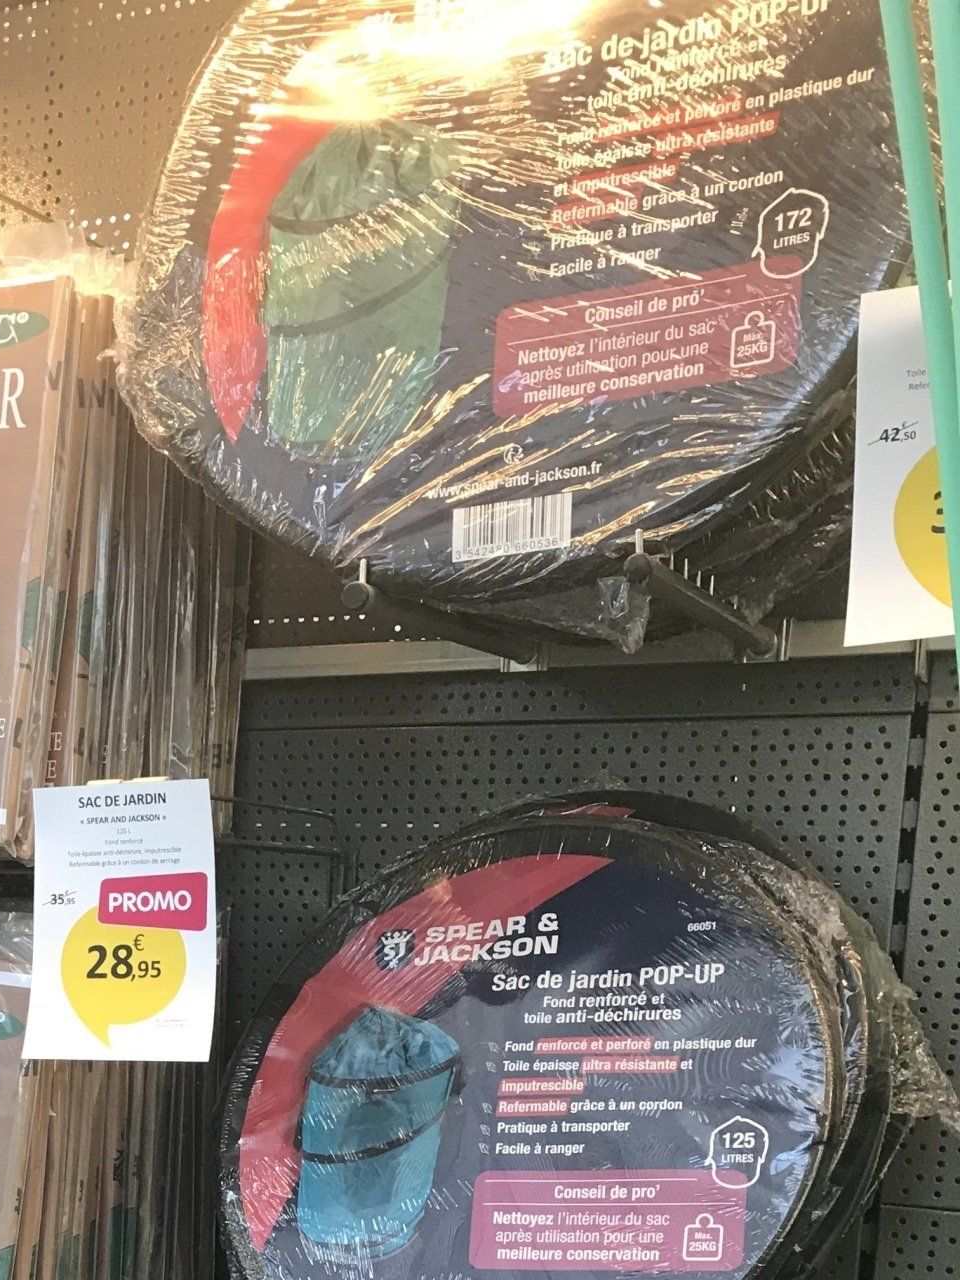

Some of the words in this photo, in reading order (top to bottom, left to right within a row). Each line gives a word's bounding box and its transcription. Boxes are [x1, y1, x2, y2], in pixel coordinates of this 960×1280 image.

[601, 34, 634, 61] de
[641, 17, 722, 58] jardin
[745, 94, 765, 109] en
[769, 76, 843, 106] plastique
[846, 66, 875, 86] dur
[552, 197, 638, 225] Refermable
[705, 182, 725, 197] un
[729, 169, 784, 194] cordon
[617, 222, 627, 239] à
[631, 207, 720, 238] transporter
[774, 208, 812, 232] 172
[773, 231, 811, 250] LITRES
[549, 258, 593, 279] Facile
[596, 252, 606, 269] à
[585, 298, 642, 324] Conseil
[647, 296, 667, 314] de
[518, 341, 585, 366] Nettoyez
[589, 328, 659, 355] l'intérieur
[664, 323, 684, 341] du
[688, 318, 716, 337] sac
[736, 341, 769, 359] 25KG
[521, 365, 562, 387] après
[566, 352, 637, 378] utilisation
[641, 348, 677, 370] pour
[680, 342, 709, 360] une
[906, 368, 927, 379] Toile
[523, 378, 597, 405] meilleure
[600, 361, 705, 393] conservation
[78, 796, 101, 809] SAC
[104, 795, 120, 807] DE
[123, 792, 167, 807] JARDIN
[86, 815, 109, 825] SPEAR
[110, 814, 127, 823] AND
[128, 813, 160, 823] JACKSON
[108, 889, 192, 913] PROMO
[425, 915, 527, 944] SPEAR
[538, 912, 560, 932] &
[687, 920, 717, 932] 66051
[86, 944, 161, 982] 28,95
[133, 933, 145, 951] €
[414, 935, 559, 967] JACKSON
[491, 972, 531, 993] Sac
[537, 969, 563, 990] de
[567, 967, 633, 993] jardin
[639, 962, 726, 987] POP-UP
[543, 995, 576, 1009] Fond
[579, 990, 648, 1008] renforcé
[651, 992, 666, 1006] et
[524, 1010, 552, 1024] toile
[555, 1005, 682, 1024] anti-déchirures
[504, 1039, 534, 1052] Fond
[537, 1038, 588, 1052] renforcé
[591, 1039, 604, 1051] et
[606, 1037, 652, 1053] perforé
[654, 1041, 670, 1051] en
[673, 1037, 732, 1052] plastique
[735, 1036, 757, 1050] dur
[502, 1059, 530, 1072] Toile
[533, 1058, 580, 1074] épaisse
[583, 1059, 611, 1072] ultra
[614, 1058, 678, 1071] résistante
[680, 1059, 694, 1071] et
[501, 1079, 584, 1094] imputrescible
[498, 1099, 568, 1113] Refermable
[570, 1099, 606, 1115] grâce
[608, 1099, 617, 1111] à
[620, 1100, 636, 1111] un
[639, 1099, 683, 1112] cordon
[497, 1121, 547, 1136] Pratique
[550, 1120, 558, 1133] à
[561, 1119, 631, 1135] transporter
[495, 1142, 531, 1155] Facile
[534, 1142, 542, 1154] à
[545, 1143, 585, 1157] ranger
[722, 1132, 756, 1149] 125
[721, 1153, 754, 1164] LITRES
[554, 1184, 606, 1200] Conseil
[610, 1184, 628, 1200] de
[493, 1211, 553, 1226] Nettoyez
[557, 1210, 622, 1226] l'intérieur
[625, 1212, 642, 1226] du
[645, 1214, 670, 1226] sac
[495, 1230, 533, 1244] après
[536, 1229, 601, 1243] utilisation
[604, 1232, 636, 1246] pour
[638, 1232, 664, 1244] une
[689, 1241, 717, 1252] 25KG
[497, 1247, 563, 1260] meilleure
[566, 1247, 660, 1261] conservation
